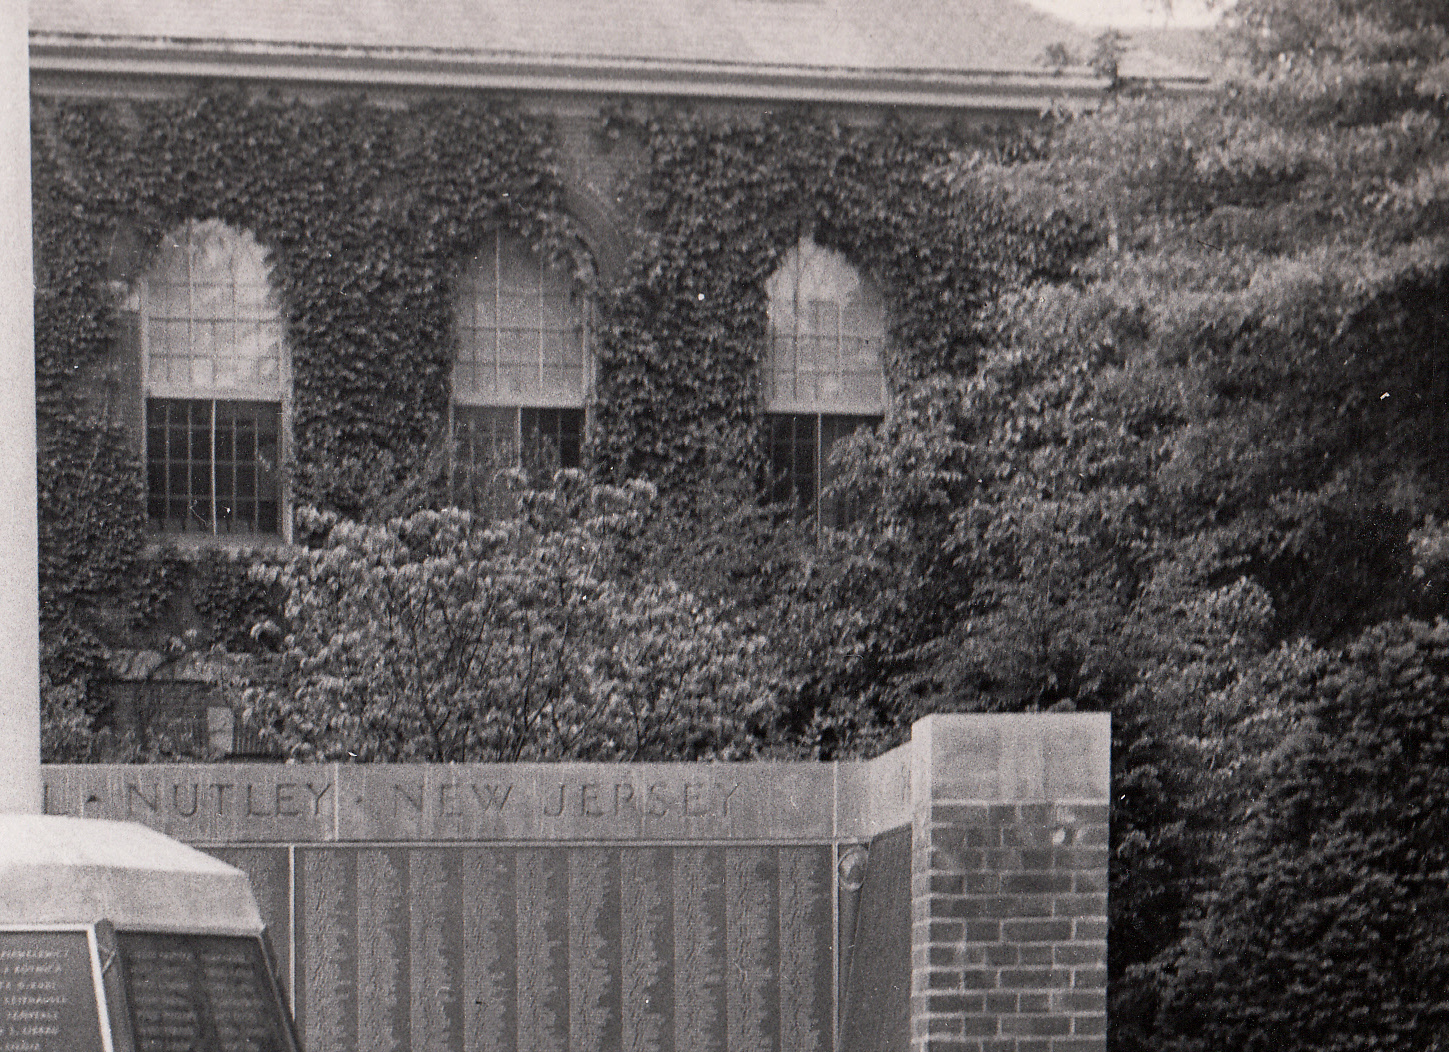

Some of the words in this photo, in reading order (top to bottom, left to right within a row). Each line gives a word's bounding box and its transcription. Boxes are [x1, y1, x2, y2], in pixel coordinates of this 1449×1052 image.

[126, 782, 332, 817] NUTLEY
[392, 782, 514, 817] NEW
[542, 782, 742, 817] JERSEY
